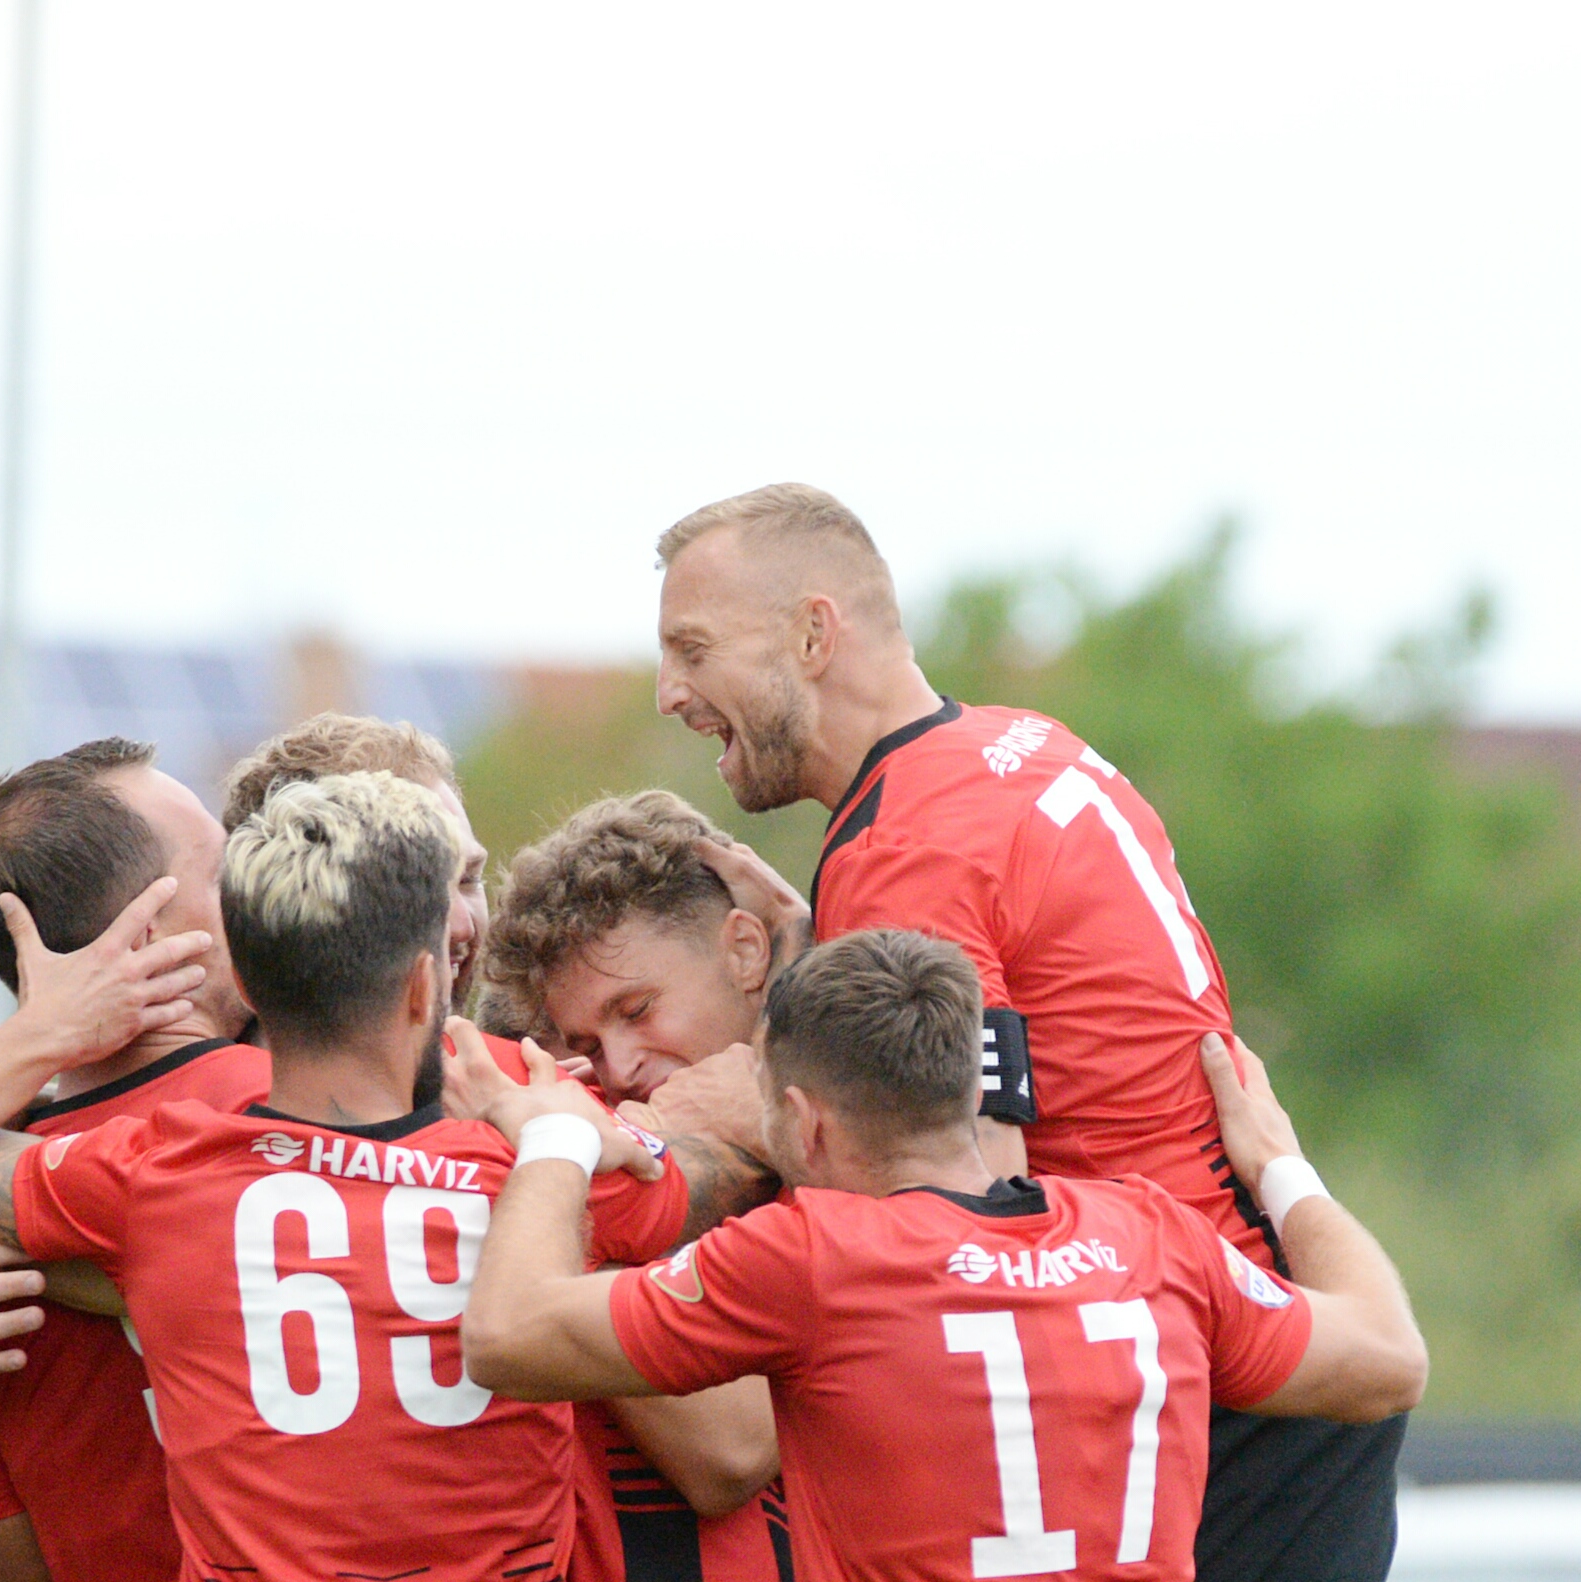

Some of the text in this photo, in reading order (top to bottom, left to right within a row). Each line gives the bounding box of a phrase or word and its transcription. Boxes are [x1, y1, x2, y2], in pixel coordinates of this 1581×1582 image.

[309, 1135, 481, 1191] HARVIZ
[234, 1172, 494, 1435] 69
[999, 1238, 1129, 1288] HARVIZ
[941, 1298, 1168, 1579] 17
